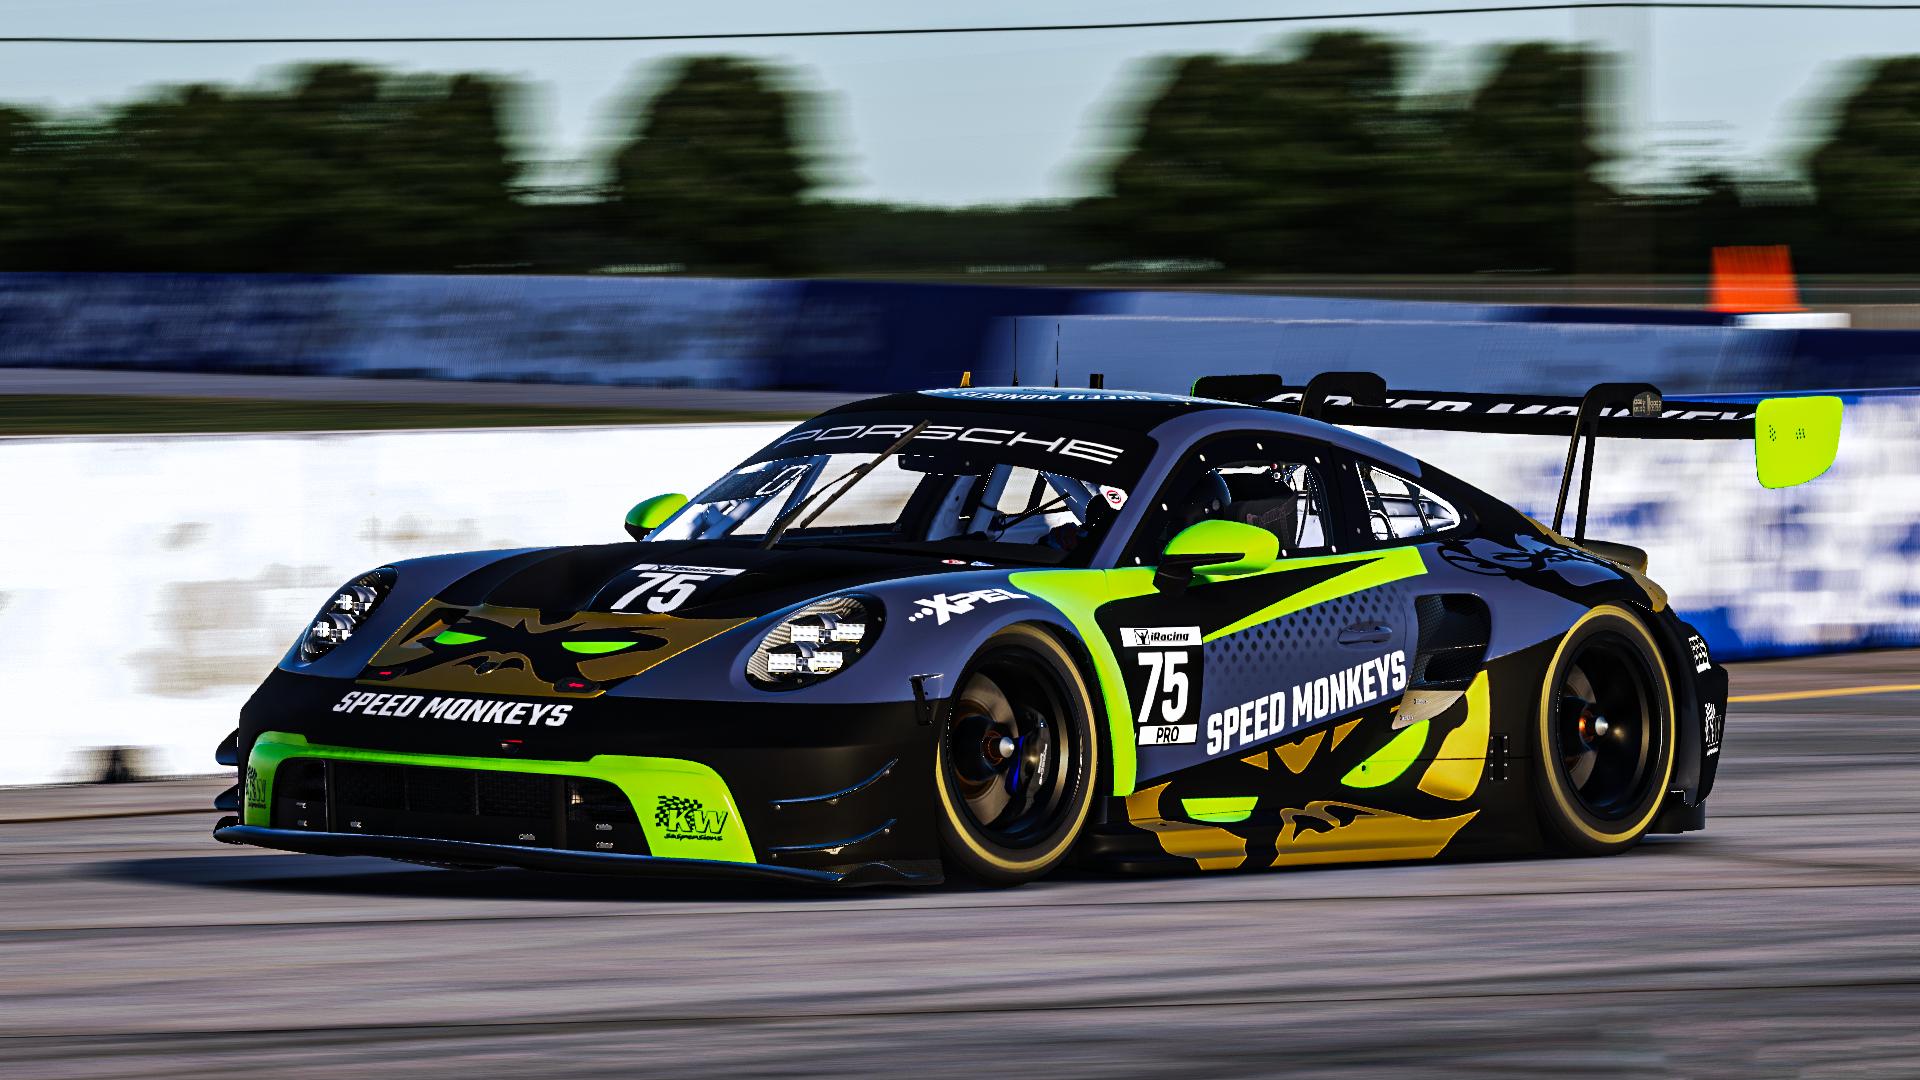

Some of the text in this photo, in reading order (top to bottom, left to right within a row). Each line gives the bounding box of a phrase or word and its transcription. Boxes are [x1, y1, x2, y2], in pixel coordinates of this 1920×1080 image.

[773, 424, 1125, 465] PORSCHE
[610, 572, 711, 613] 75
[910, 588, 1030, 625] XPEL
[1150, 631, 1189, 642] iRacing
[1137, 650, 1189, 723] 75
[1206, 649, 1407, 756] SPEED MONKEYS
[332, 690, 574, 727] SPEED MONKEYS
[1156, 726, 1179, 743] PRO
[666, 809, 728, 834] KW
